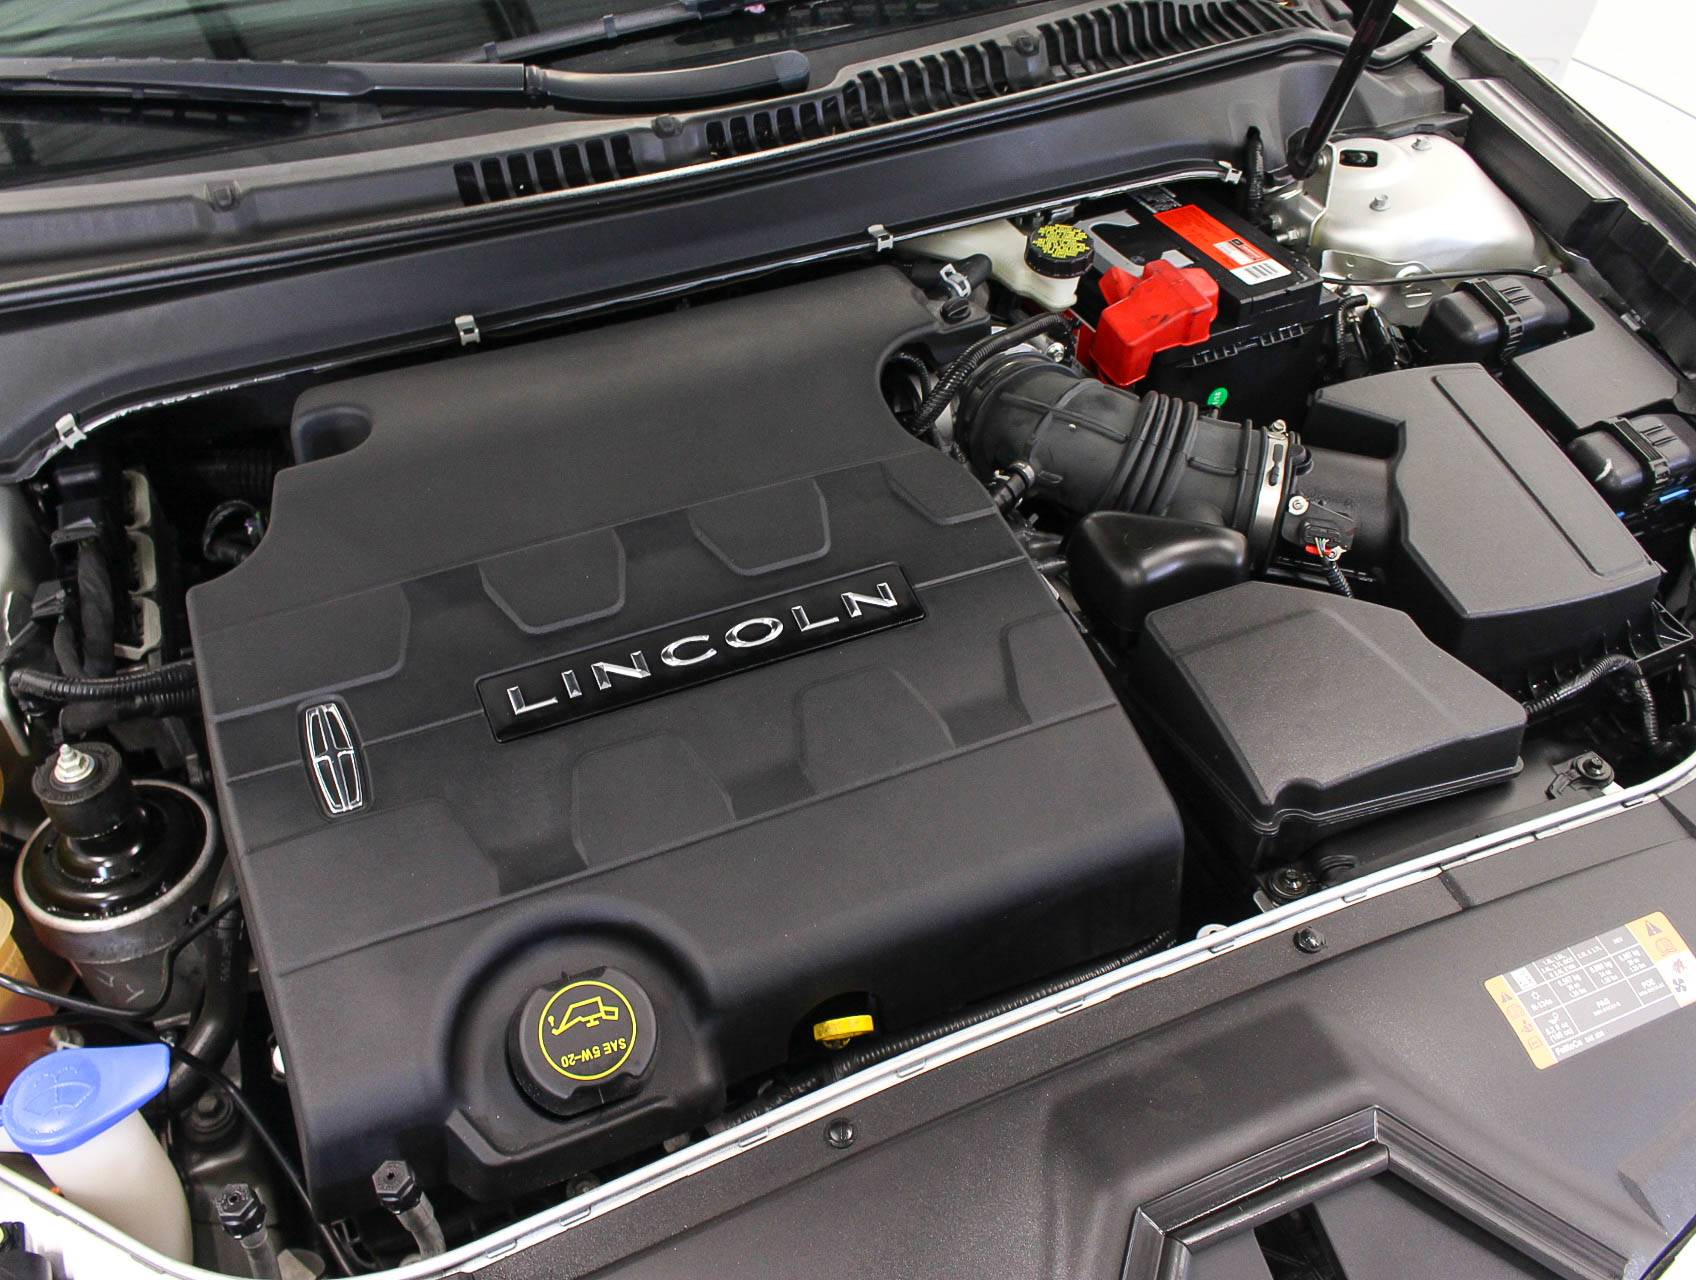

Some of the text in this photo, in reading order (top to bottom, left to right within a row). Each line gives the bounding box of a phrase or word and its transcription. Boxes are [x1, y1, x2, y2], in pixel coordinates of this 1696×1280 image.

[507, 582, 898, 715] LINCOLN
[560, 1037, 627, 1068] SAE 5W-20
